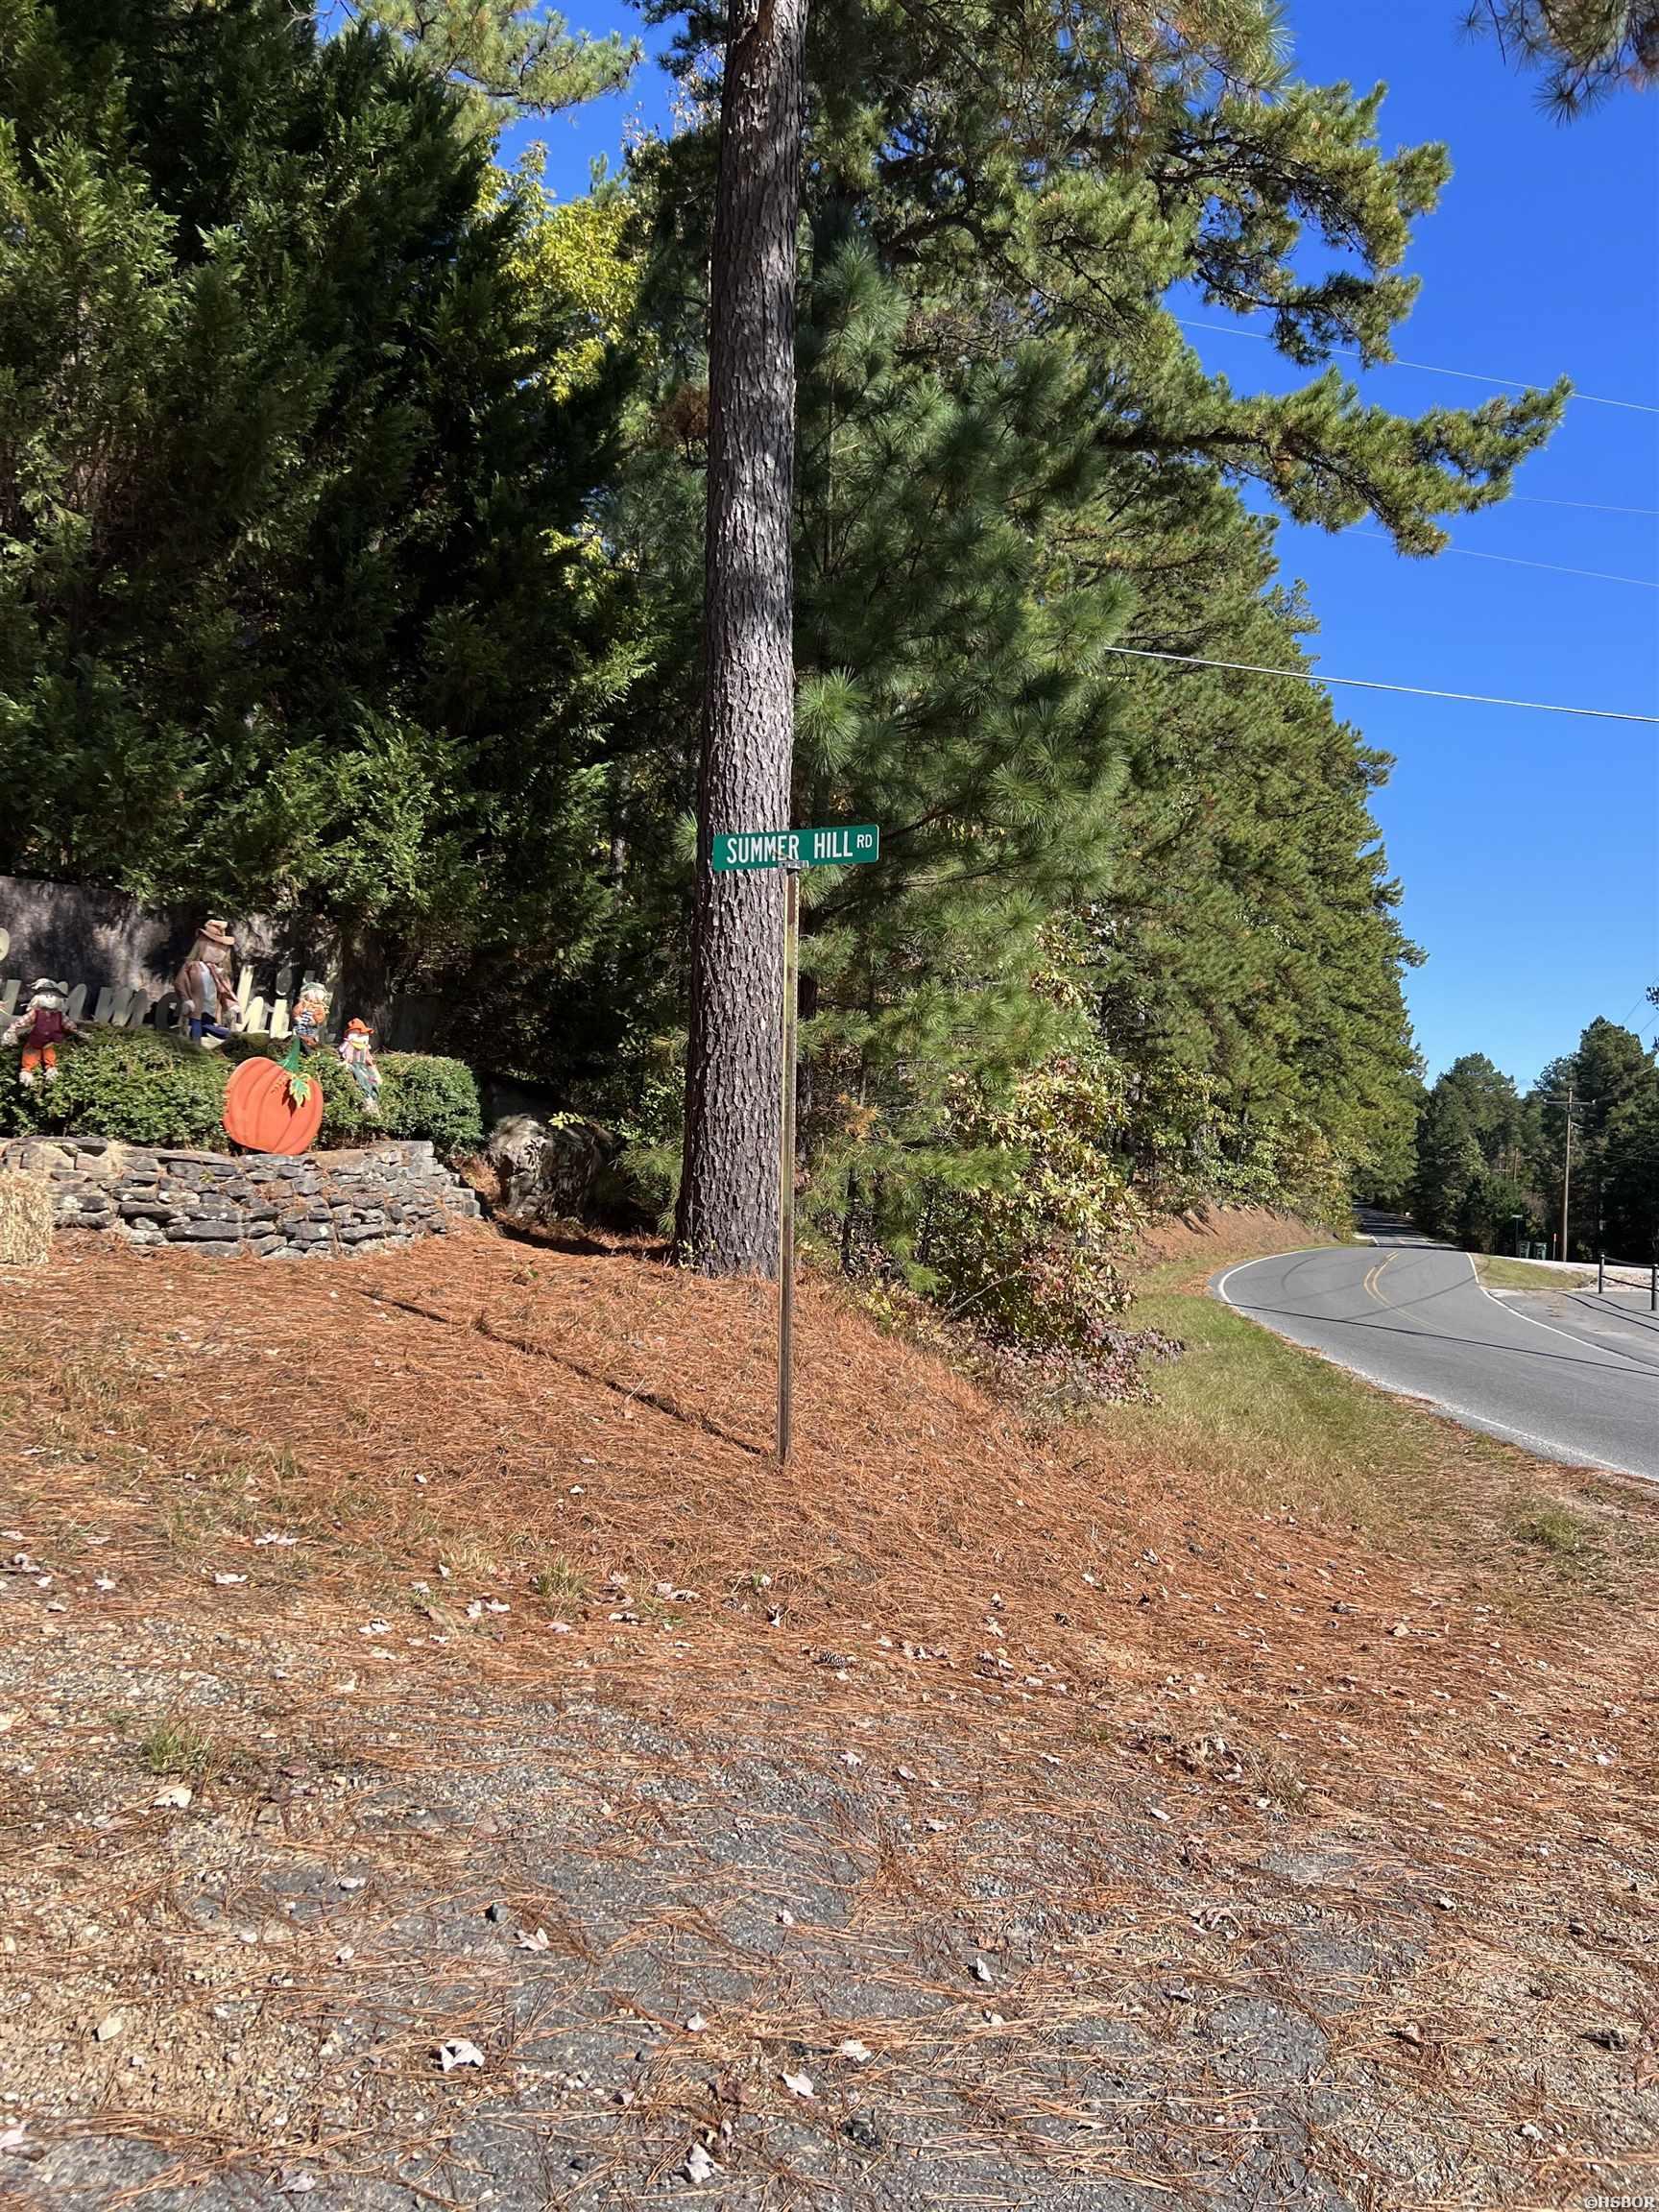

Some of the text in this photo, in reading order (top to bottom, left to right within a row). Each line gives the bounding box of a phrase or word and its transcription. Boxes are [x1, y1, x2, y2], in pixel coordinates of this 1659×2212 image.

[727, 830, 873, 864] SUMMER HILL RD
